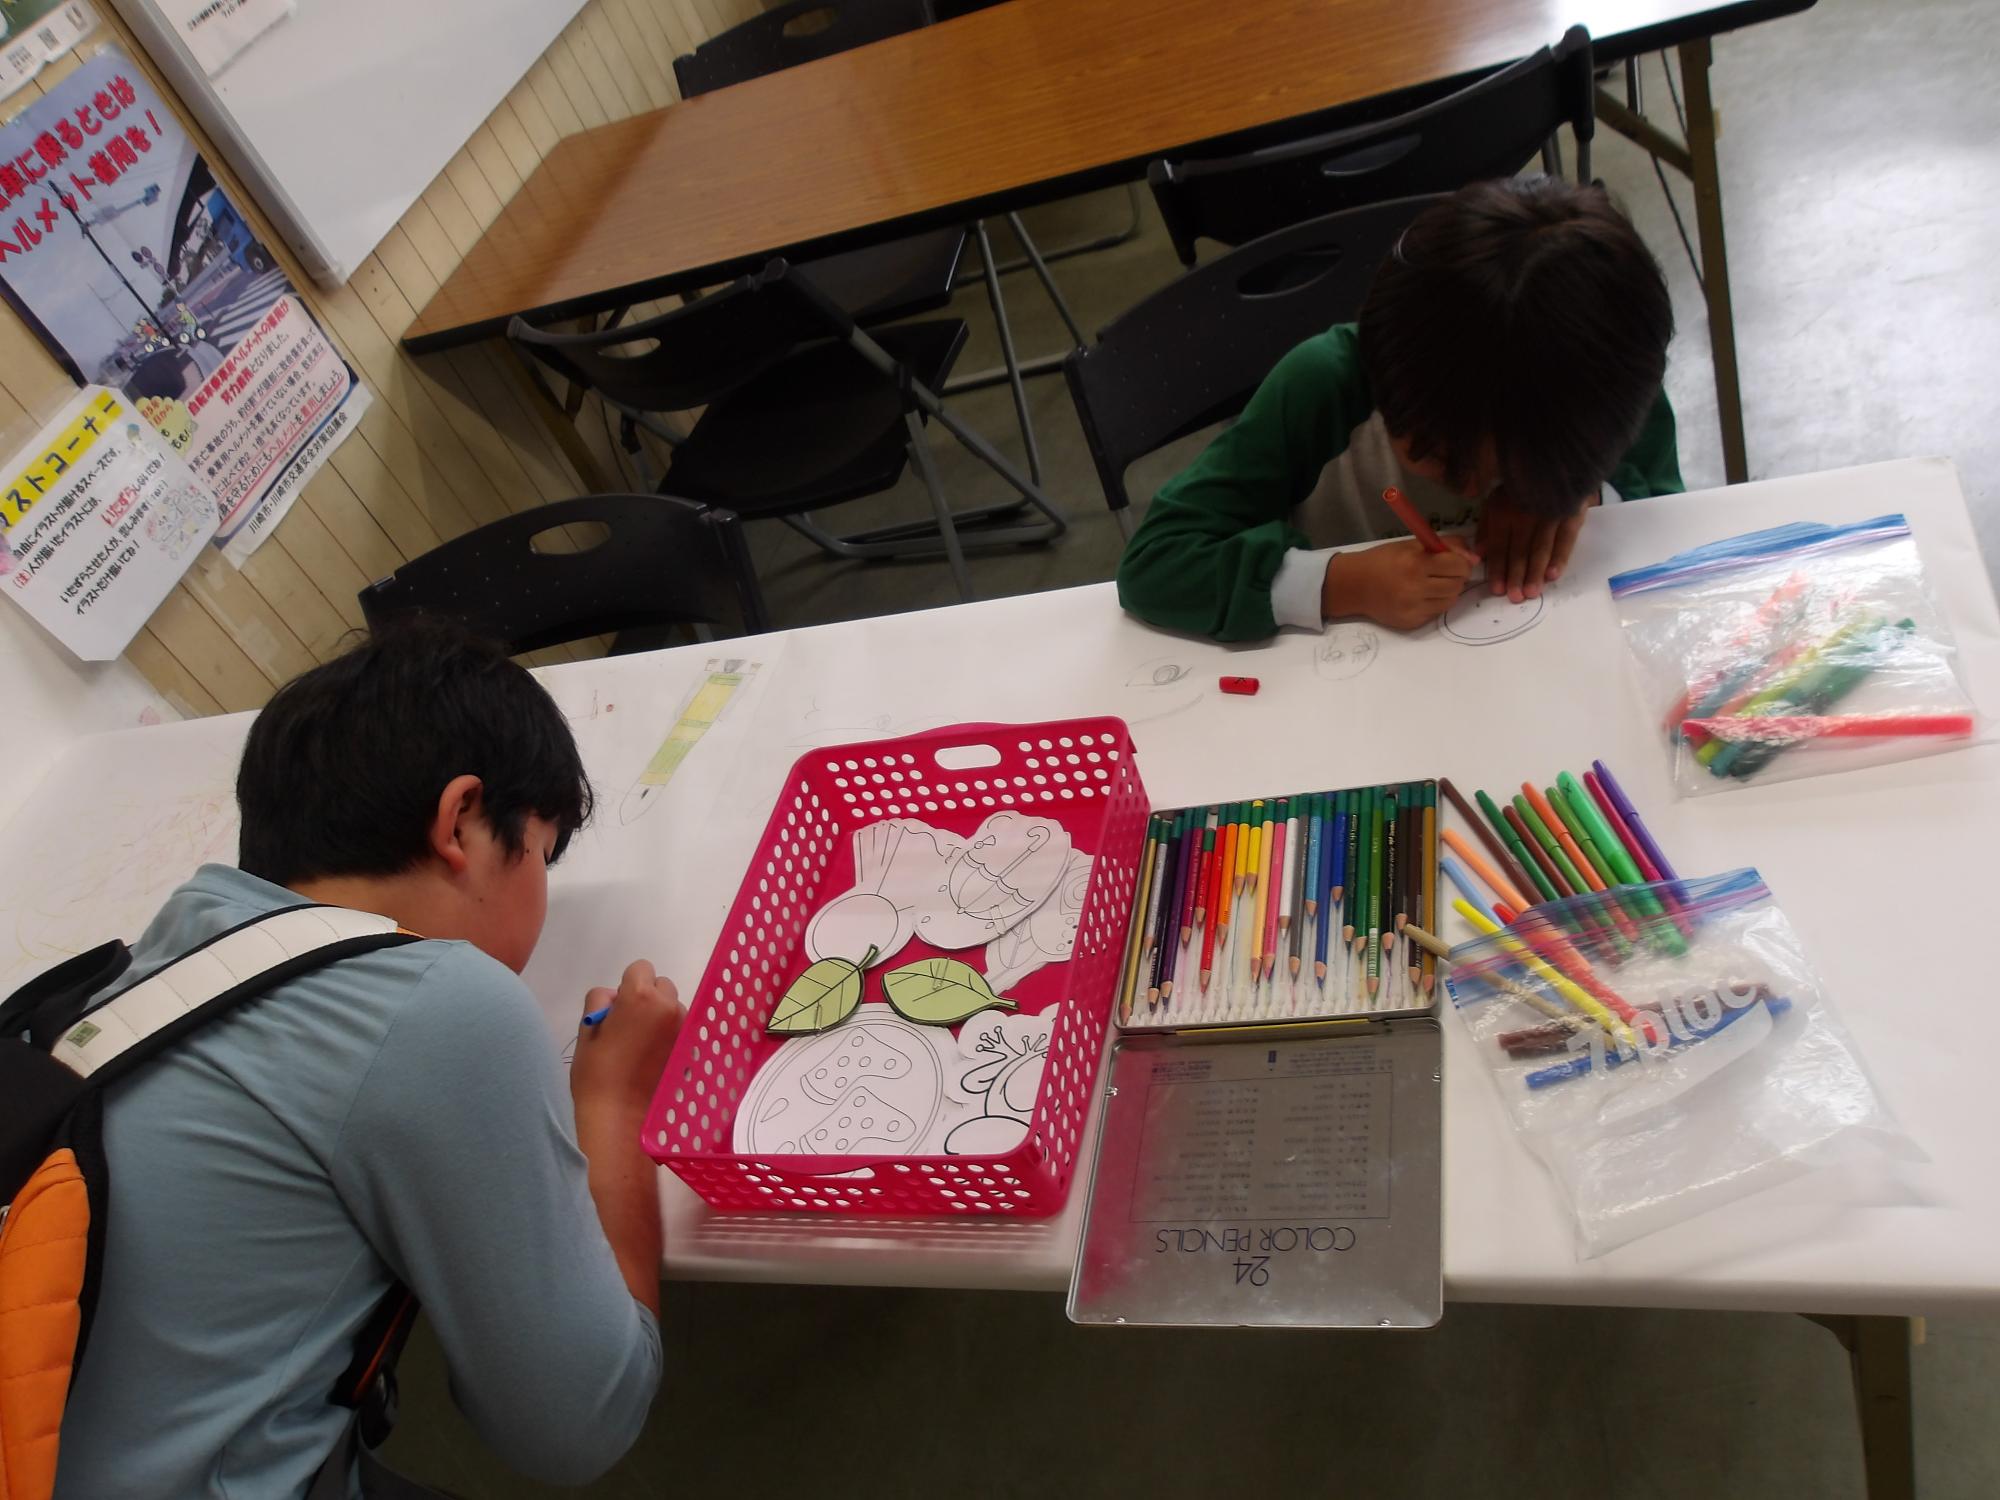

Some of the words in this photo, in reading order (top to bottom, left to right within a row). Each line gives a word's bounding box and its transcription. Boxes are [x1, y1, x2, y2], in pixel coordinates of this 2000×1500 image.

[1155, 1228, 1251, 1253] PENCILS
[1260, 1227, 1356, 1251] COLOR
[1233, 1256, 1270, 1286] 24
